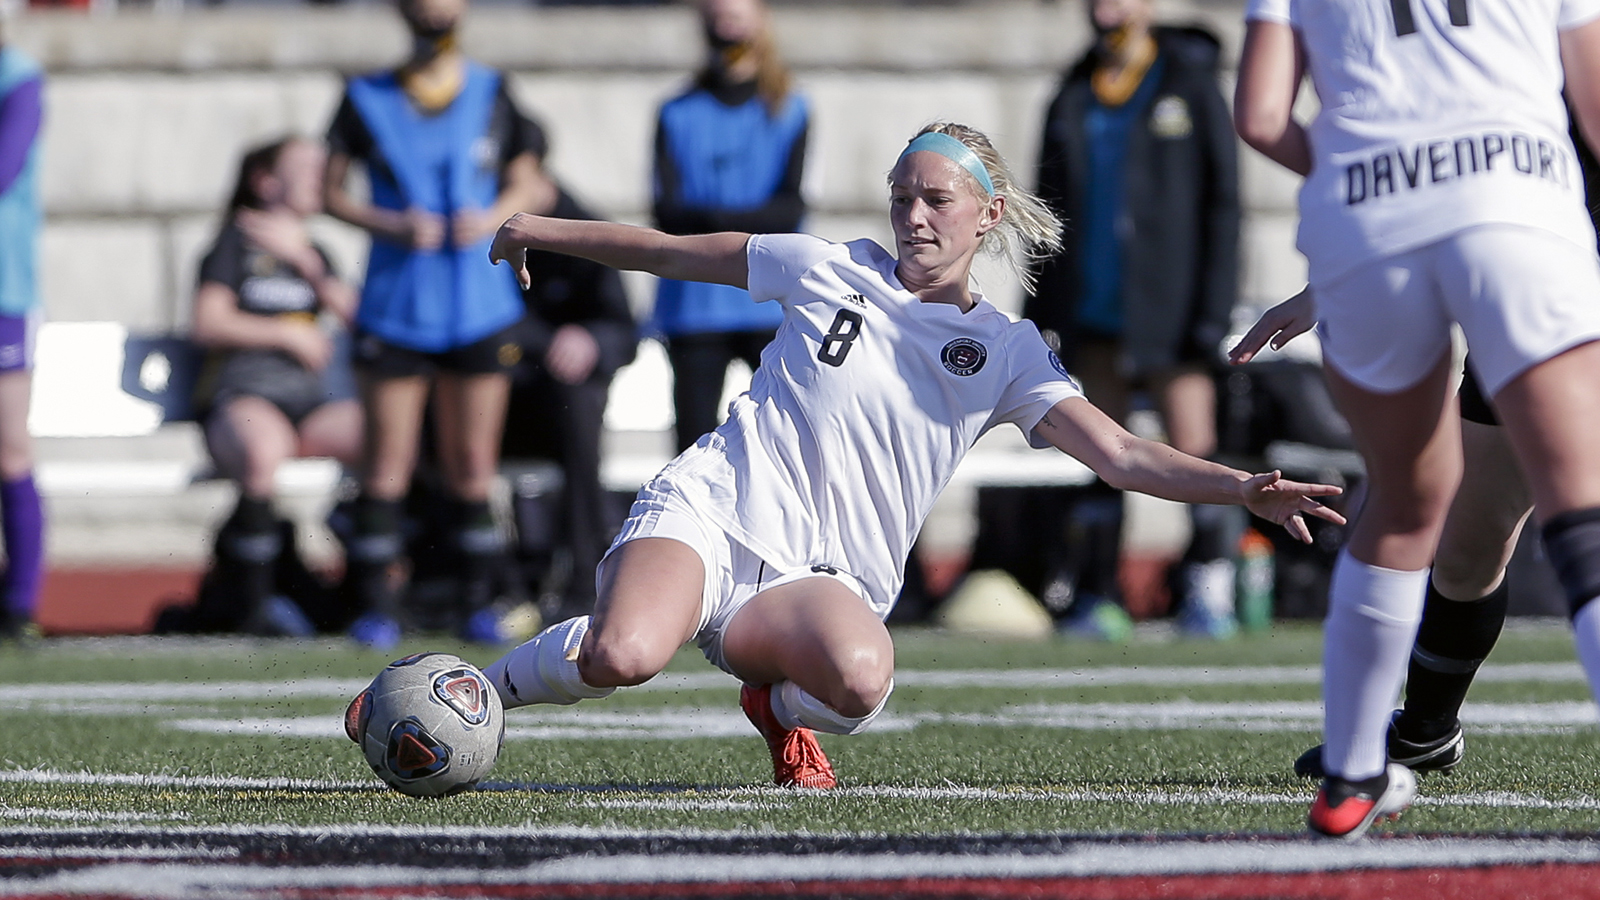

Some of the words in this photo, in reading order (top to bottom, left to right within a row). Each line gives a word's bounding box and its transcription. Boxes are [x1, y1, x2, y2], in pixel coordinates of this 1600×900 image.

[1345, 133, 1571, 206] DAVENPORT
[817, 308, 863, 368] 8
[943, 361, 973, 376] SOCCER
